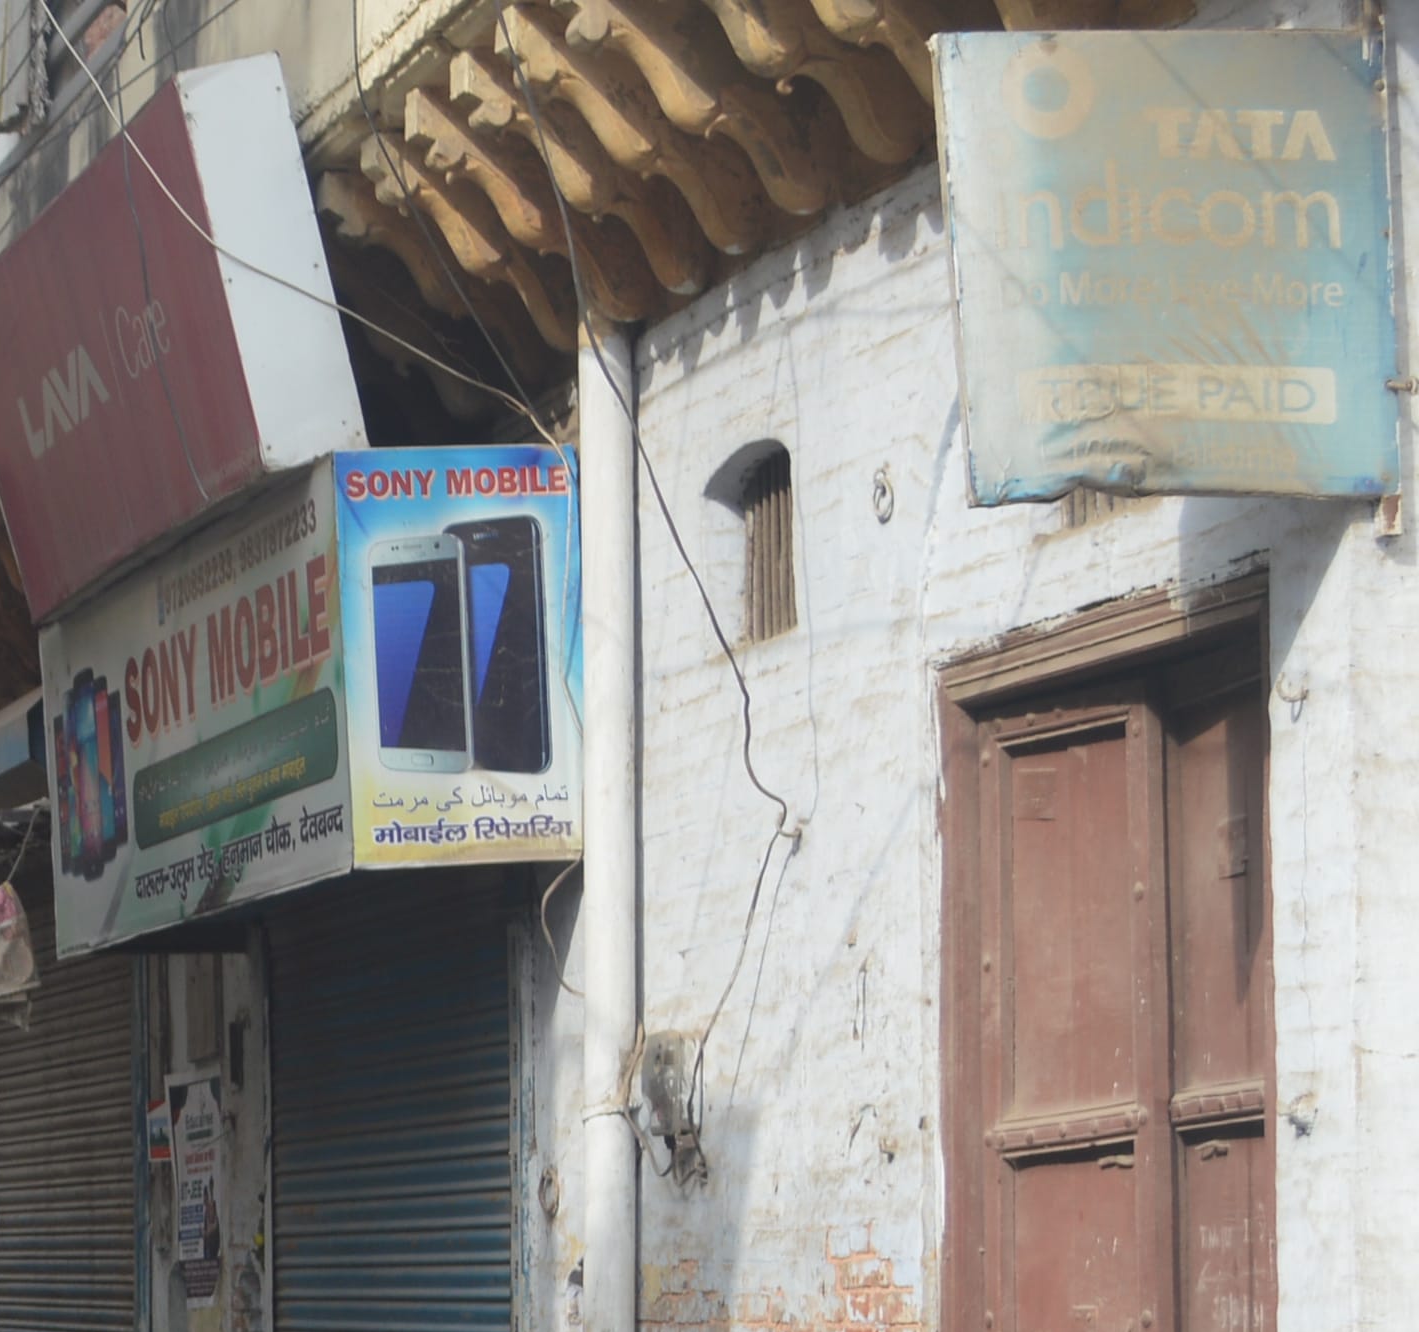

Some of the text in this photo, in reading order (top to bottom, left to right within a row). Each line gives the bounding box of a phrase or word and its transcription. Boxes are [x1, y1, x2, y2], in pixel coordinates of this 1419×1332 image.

[1146, 108, 1338, 162] TATA
[995, 157, 1343, 251] indicom
[1251, 271, 1347, 308] More
[16, 299, 171, 461] LAVA Care
[1198, 377, 1317, 413] PAID
[345, 464, 569, 502] SONY MOBILE
[123, 553, 332, 748] SONY MOBILE
[535, 783, 570, 811] تمام
[299, 804, 344, 844] देवबन्द
[373, 814, 574, 844] मोबाईल रिपेयरिंग
